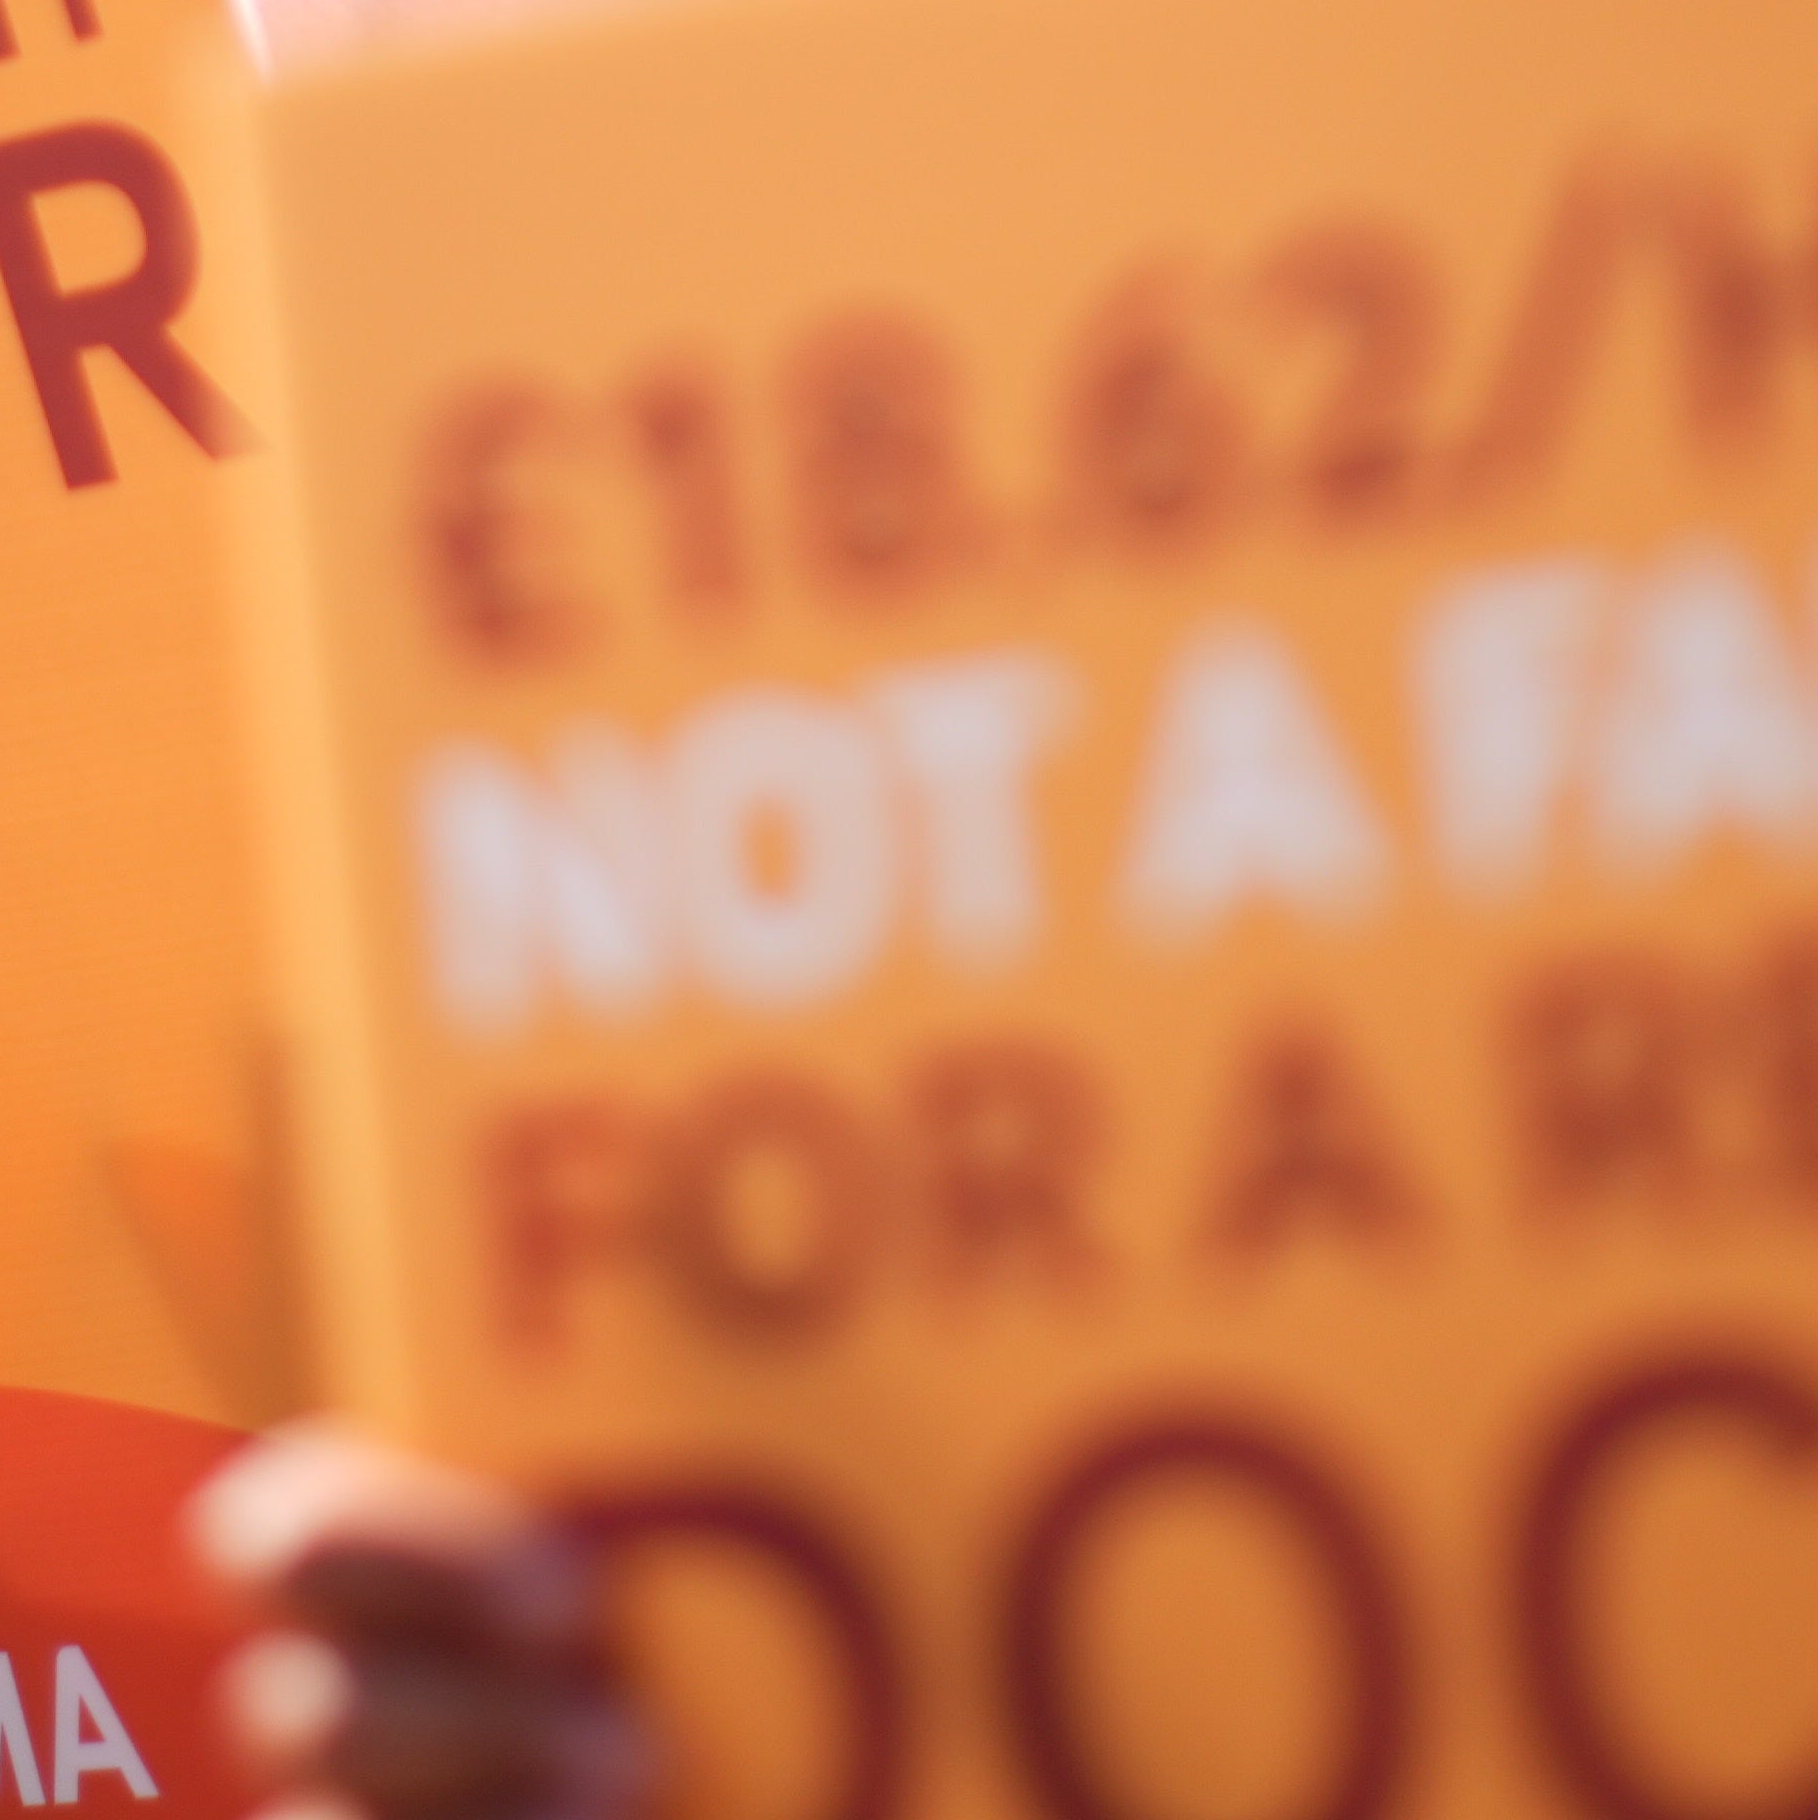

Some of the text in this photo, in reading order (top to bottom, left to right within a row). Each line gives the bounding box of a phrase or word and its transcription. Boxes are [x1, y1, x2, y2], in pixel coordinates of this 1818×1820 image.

[410, 657, 1071, 1040] NOT
[1118, 617, 1385, 941] A
[464, 1035, 1121, 1367] FOR
[1201, 1008, 1436, 1278] A
